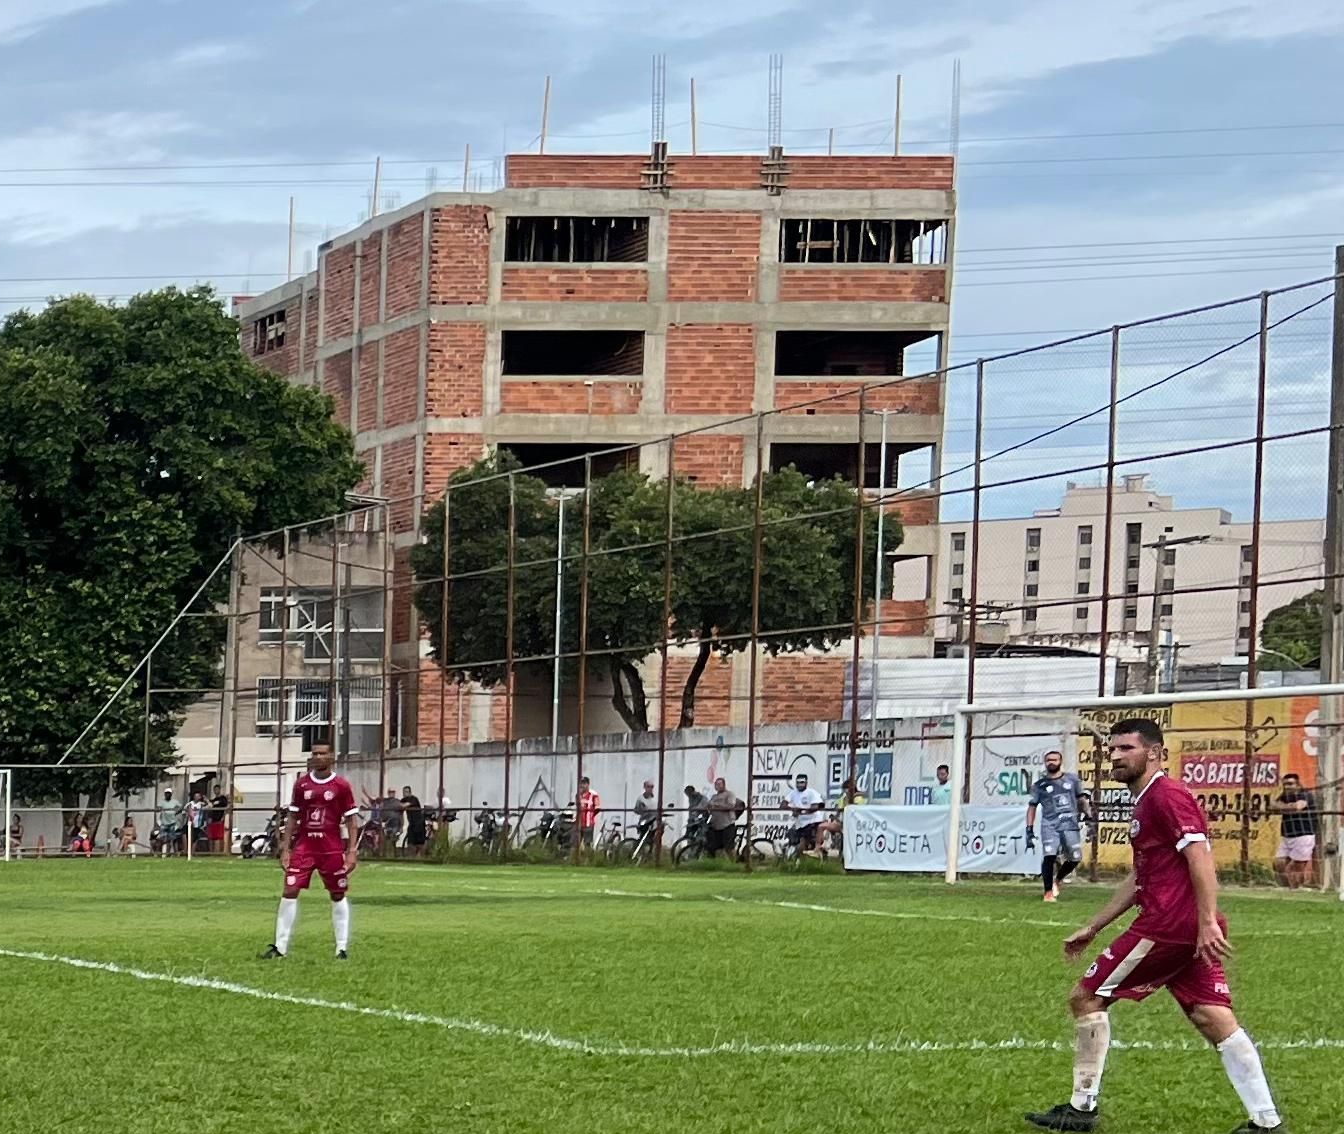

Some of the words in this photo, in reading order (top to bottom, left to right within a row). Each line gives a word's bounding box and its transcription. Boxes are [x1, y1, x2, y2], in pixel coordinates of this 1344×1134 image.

[756, 749, 789, 771] NEW
[1183, 757, 1205, 784] SÓ
[1207, 762, 1278, 784] BATEIAS
[856, 833, 932, 853] PROJETA
